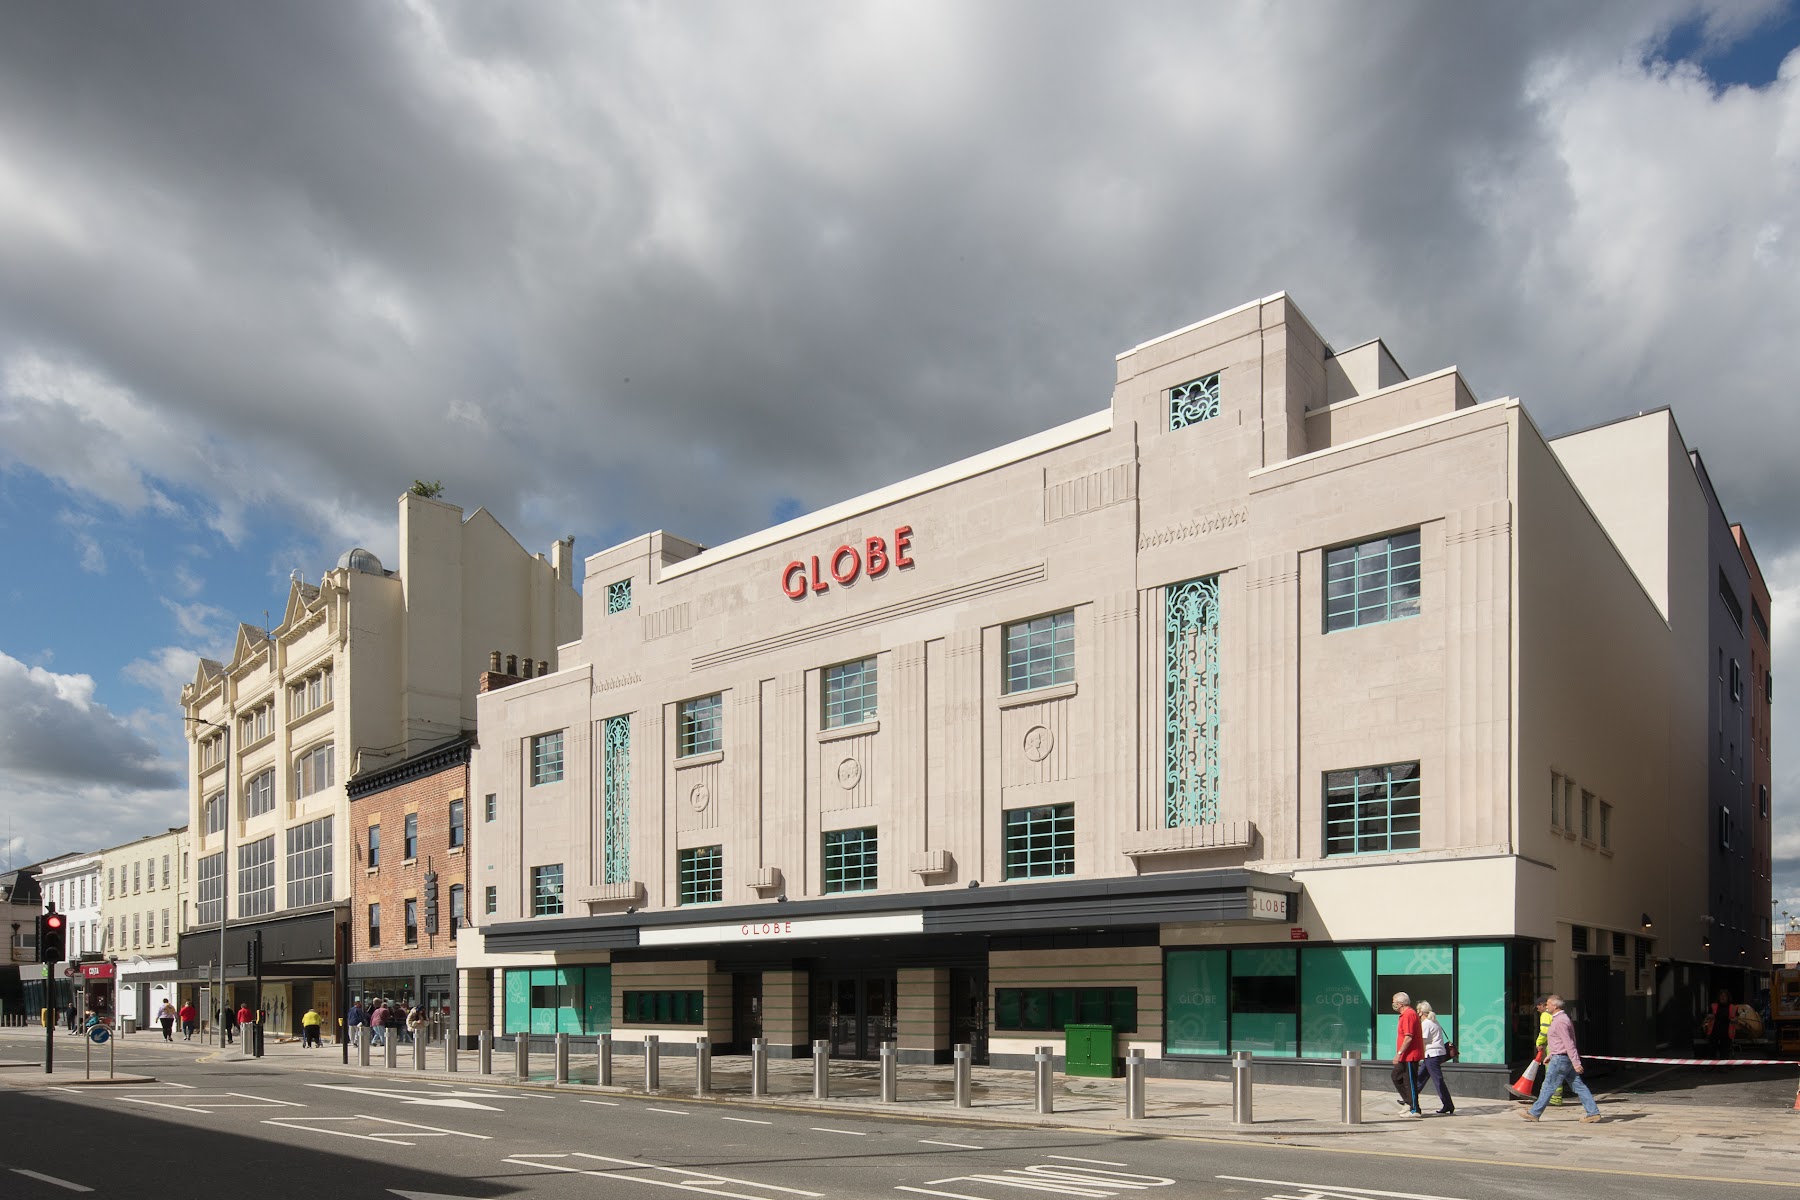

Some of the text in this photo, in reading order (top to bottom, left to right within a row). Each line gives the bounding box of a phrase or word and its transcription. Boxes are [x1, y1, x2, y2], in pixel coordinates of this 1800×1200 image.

[782, 525, 913, 599] GLOBE
[1252, 898, 1285, 913] GLOBE
[741, 921, 791, 935] GLOBE
[1179, 993, 1217, 1005] GLOBE
[1316, 993, 1359, 1006] GLOBE
